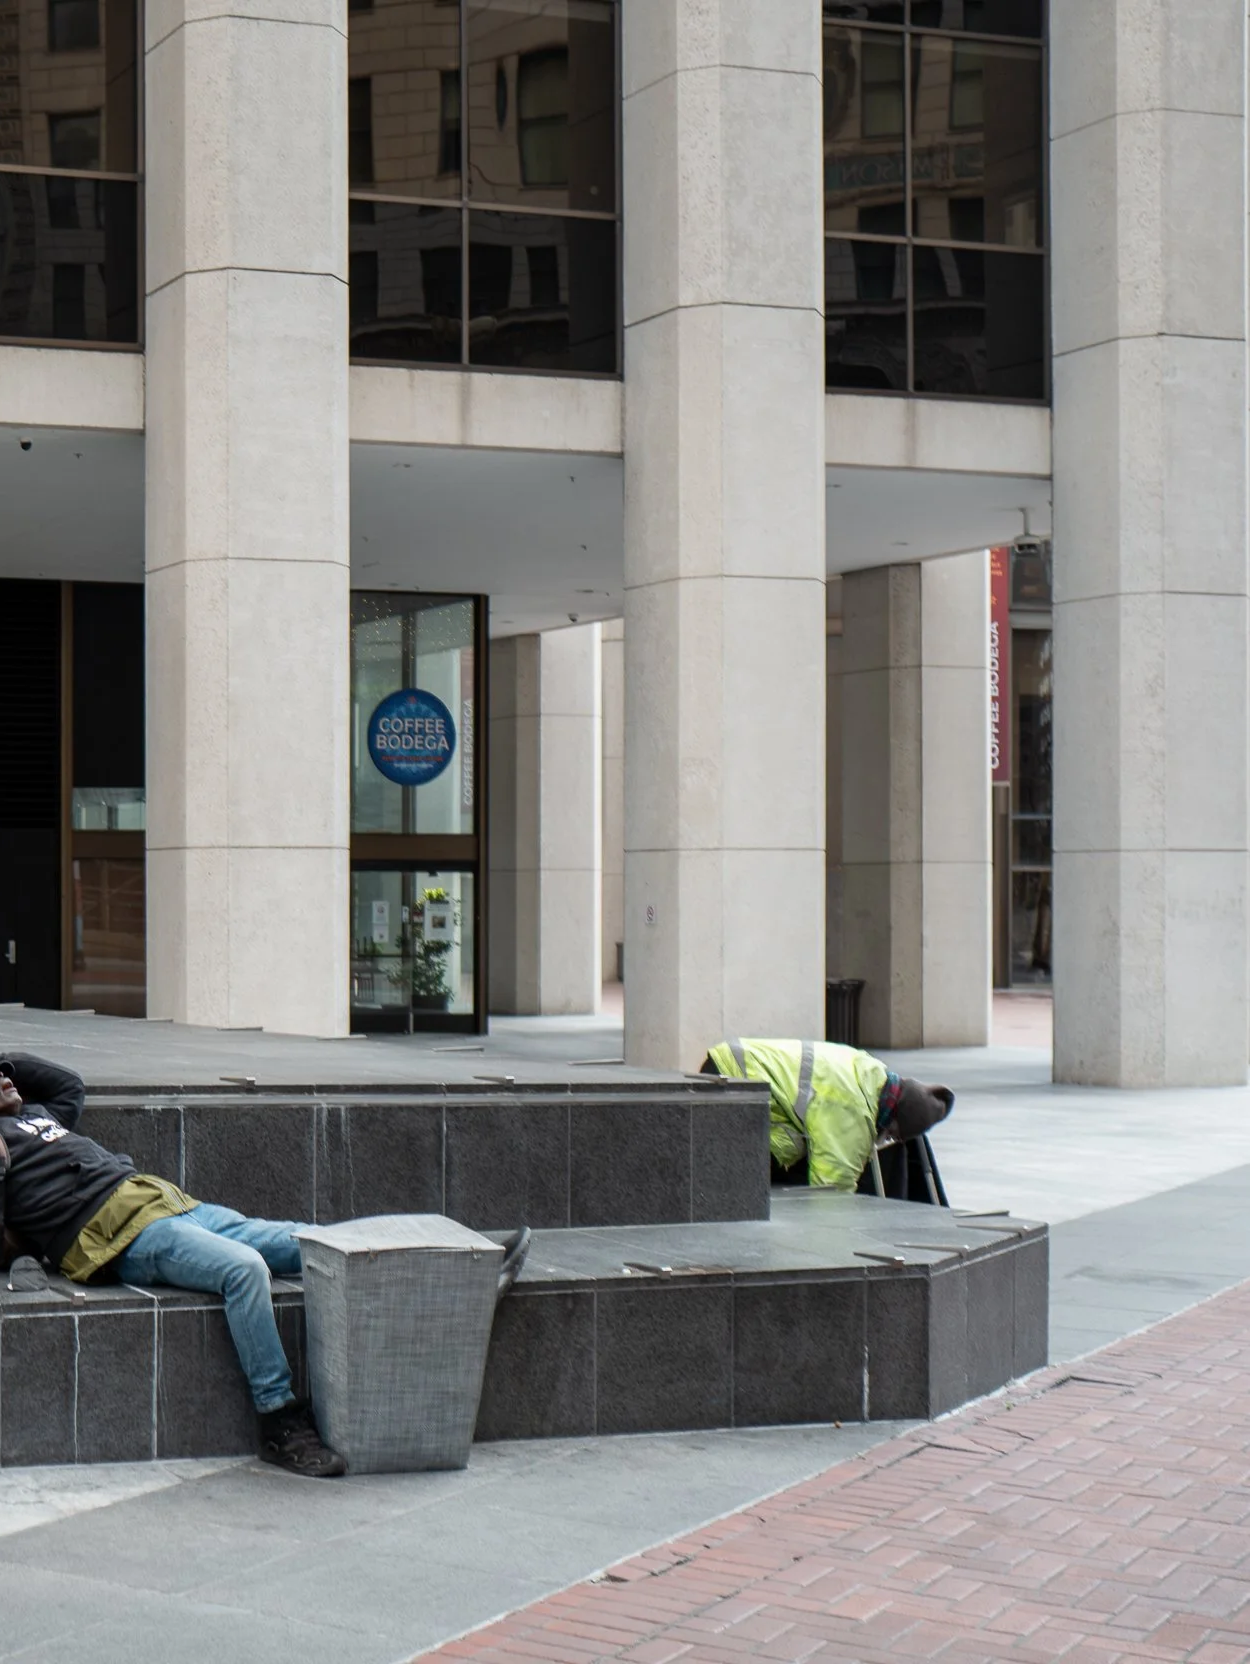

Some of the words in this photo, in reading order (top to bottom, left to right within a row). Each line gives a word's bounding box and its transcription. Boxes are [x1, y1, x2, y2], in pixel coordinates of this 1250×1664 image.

[990, 620, 1000, 697] BODEGA
[376, 735, 449, 750] BODEGA
[378, 718, 445, 734] COFFEE
[463, 700, 473, 752] BODEGA
[990, 701, 1000, 769] COFFEE
[463, 755, 473, 805] COFFEE
